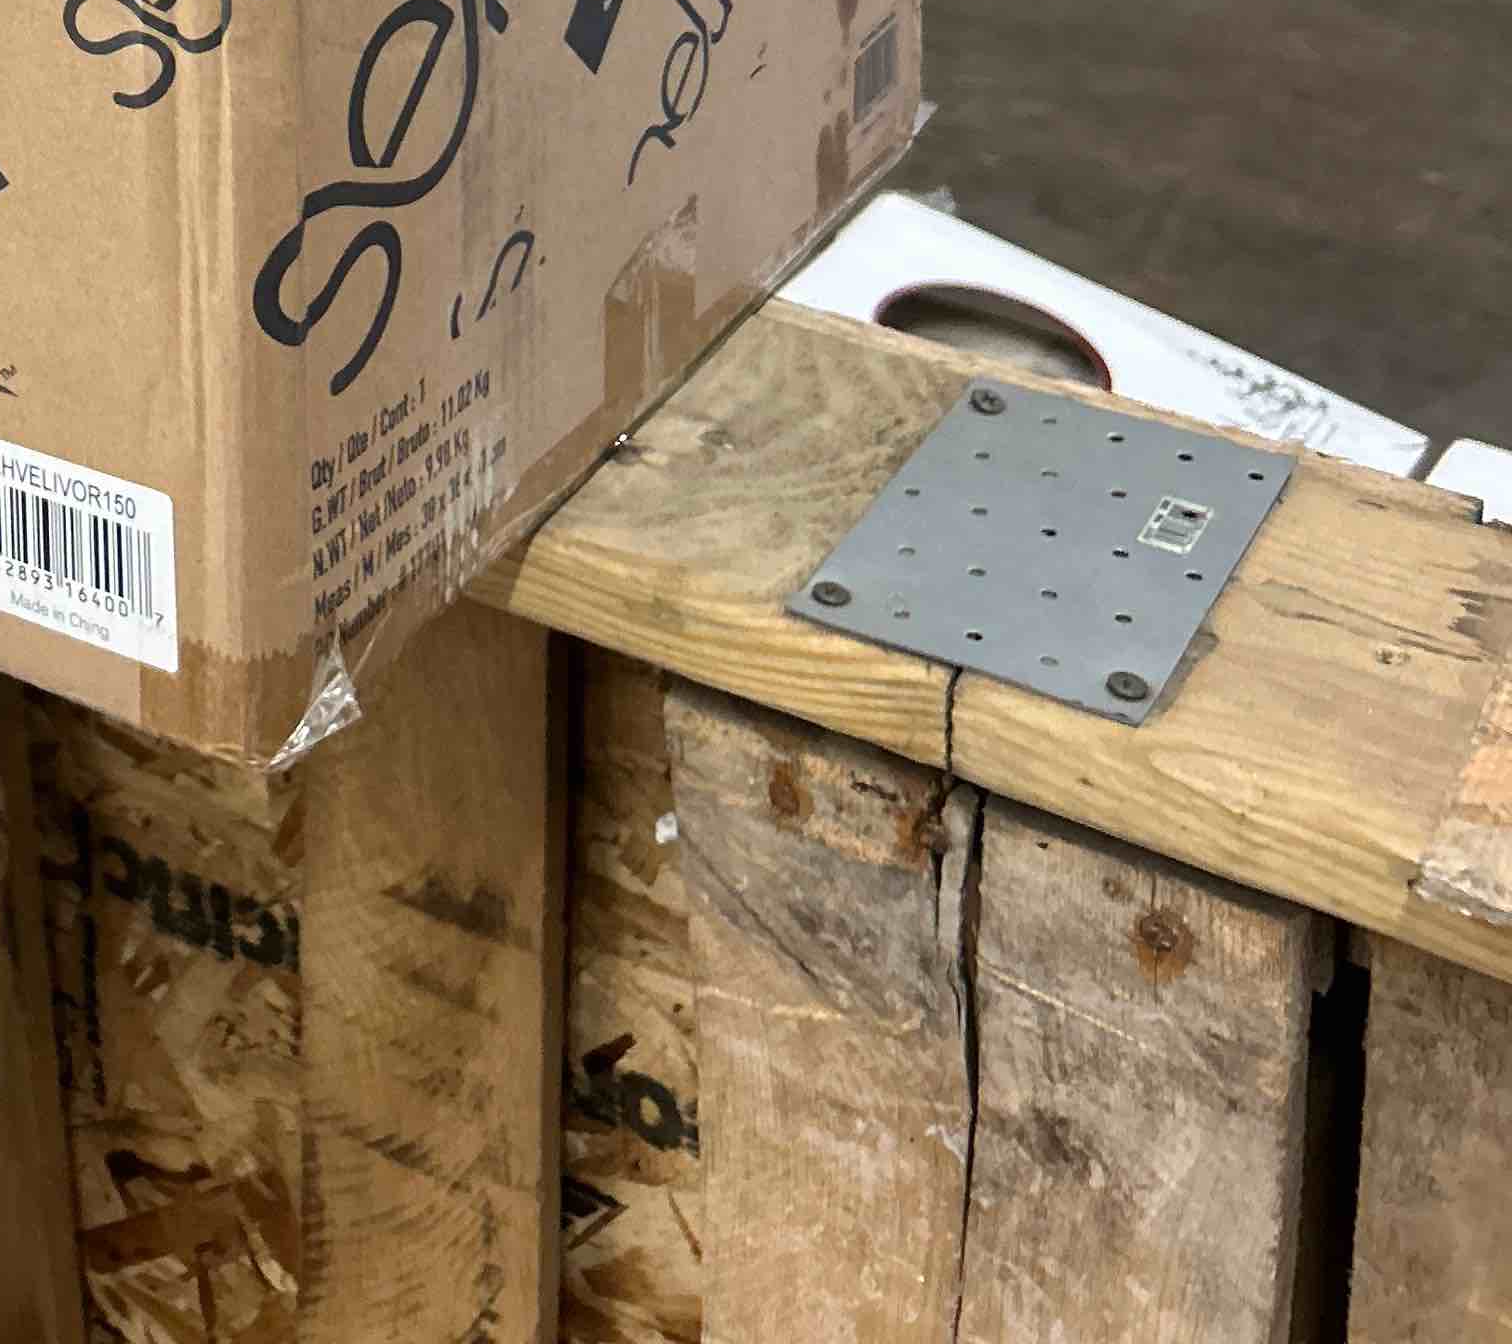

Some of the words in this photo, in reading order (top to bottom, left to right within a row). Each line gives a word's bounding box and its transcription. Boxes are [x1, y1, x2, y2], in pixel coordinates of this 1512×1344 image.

[10, 590, 49, 618] Made
[53, 607, 65, 625] in
[65, 582, 129, 617] 16400
[154, 613, 165, 629] 7
